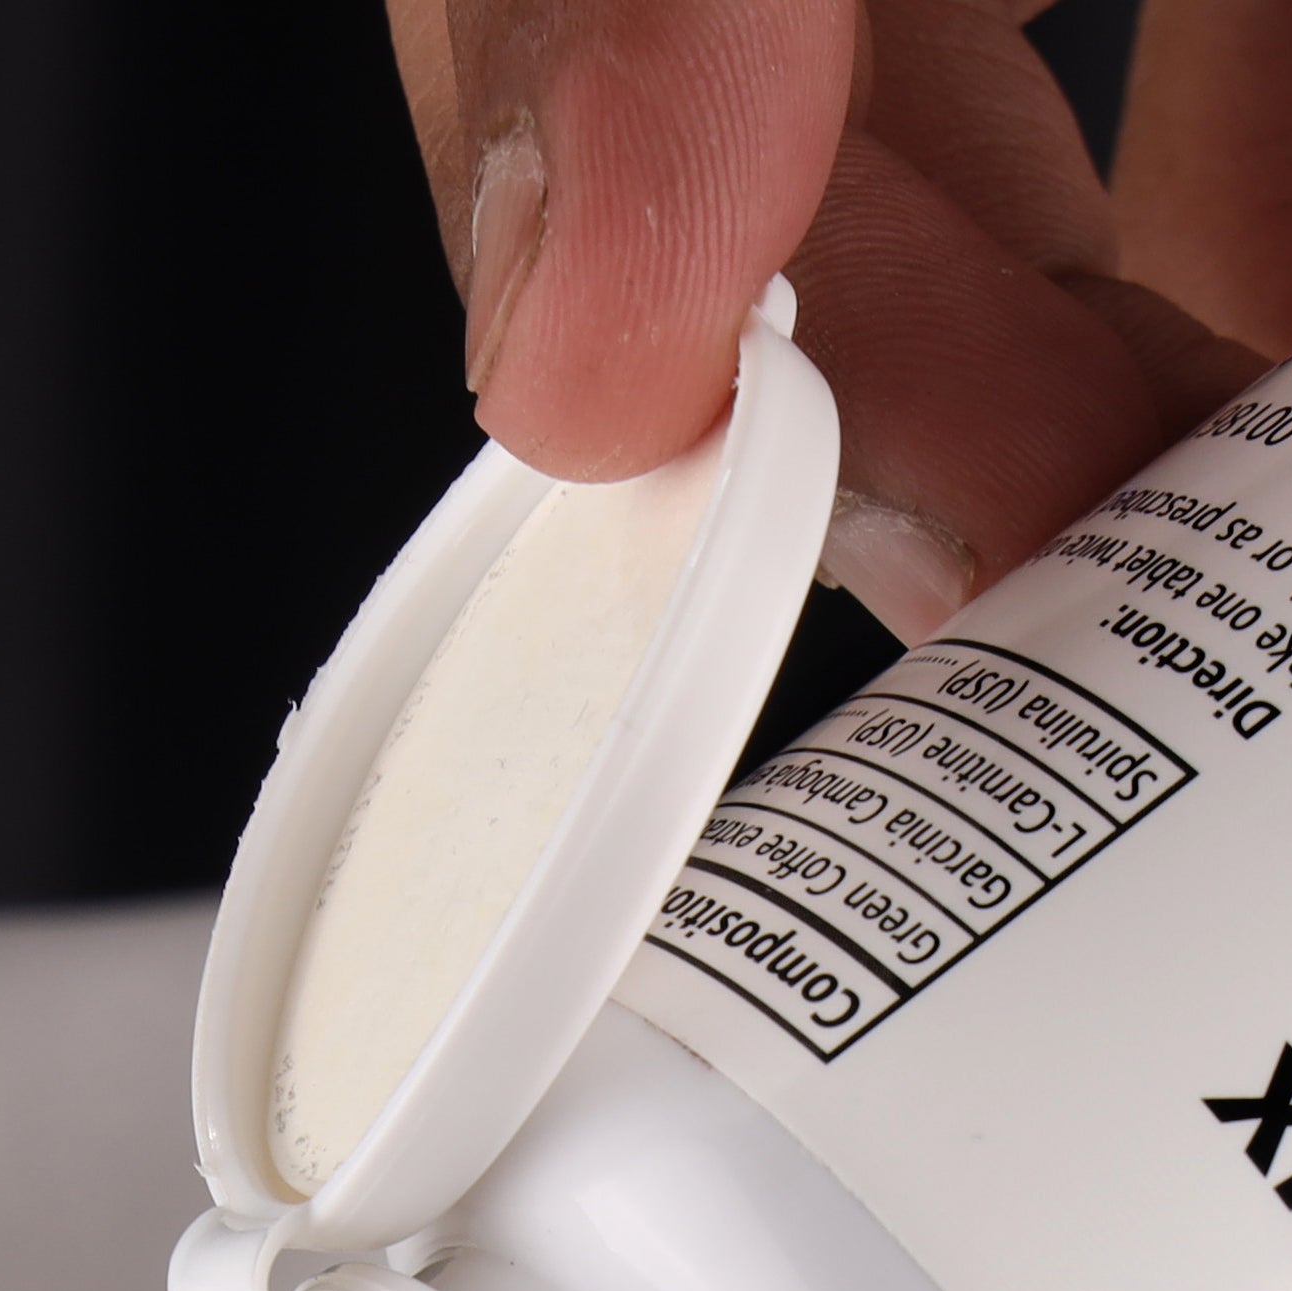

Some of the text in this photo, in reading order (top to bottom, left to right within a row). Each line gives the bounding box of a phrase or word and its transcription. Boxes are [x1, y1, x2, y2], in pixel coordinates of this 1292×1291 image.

[1112, 544, 1204, 600] tablet
[1215, 517, 1264, 550] as
[1196, 583, 1263, 632] one
[1099, 603, 1282, 741] Direction:
[847, 707, 1087, 860] L-Carnitine (USP)
[937, 659, 1158, 802] Spirulina (USP)
[755, 834, 847, 897] Coffee
[765, 759, 1012, 911] Garcinia Cambogia
[660, 886, 862, 1030] Compositio
[845, 884, 942, 966] Green
